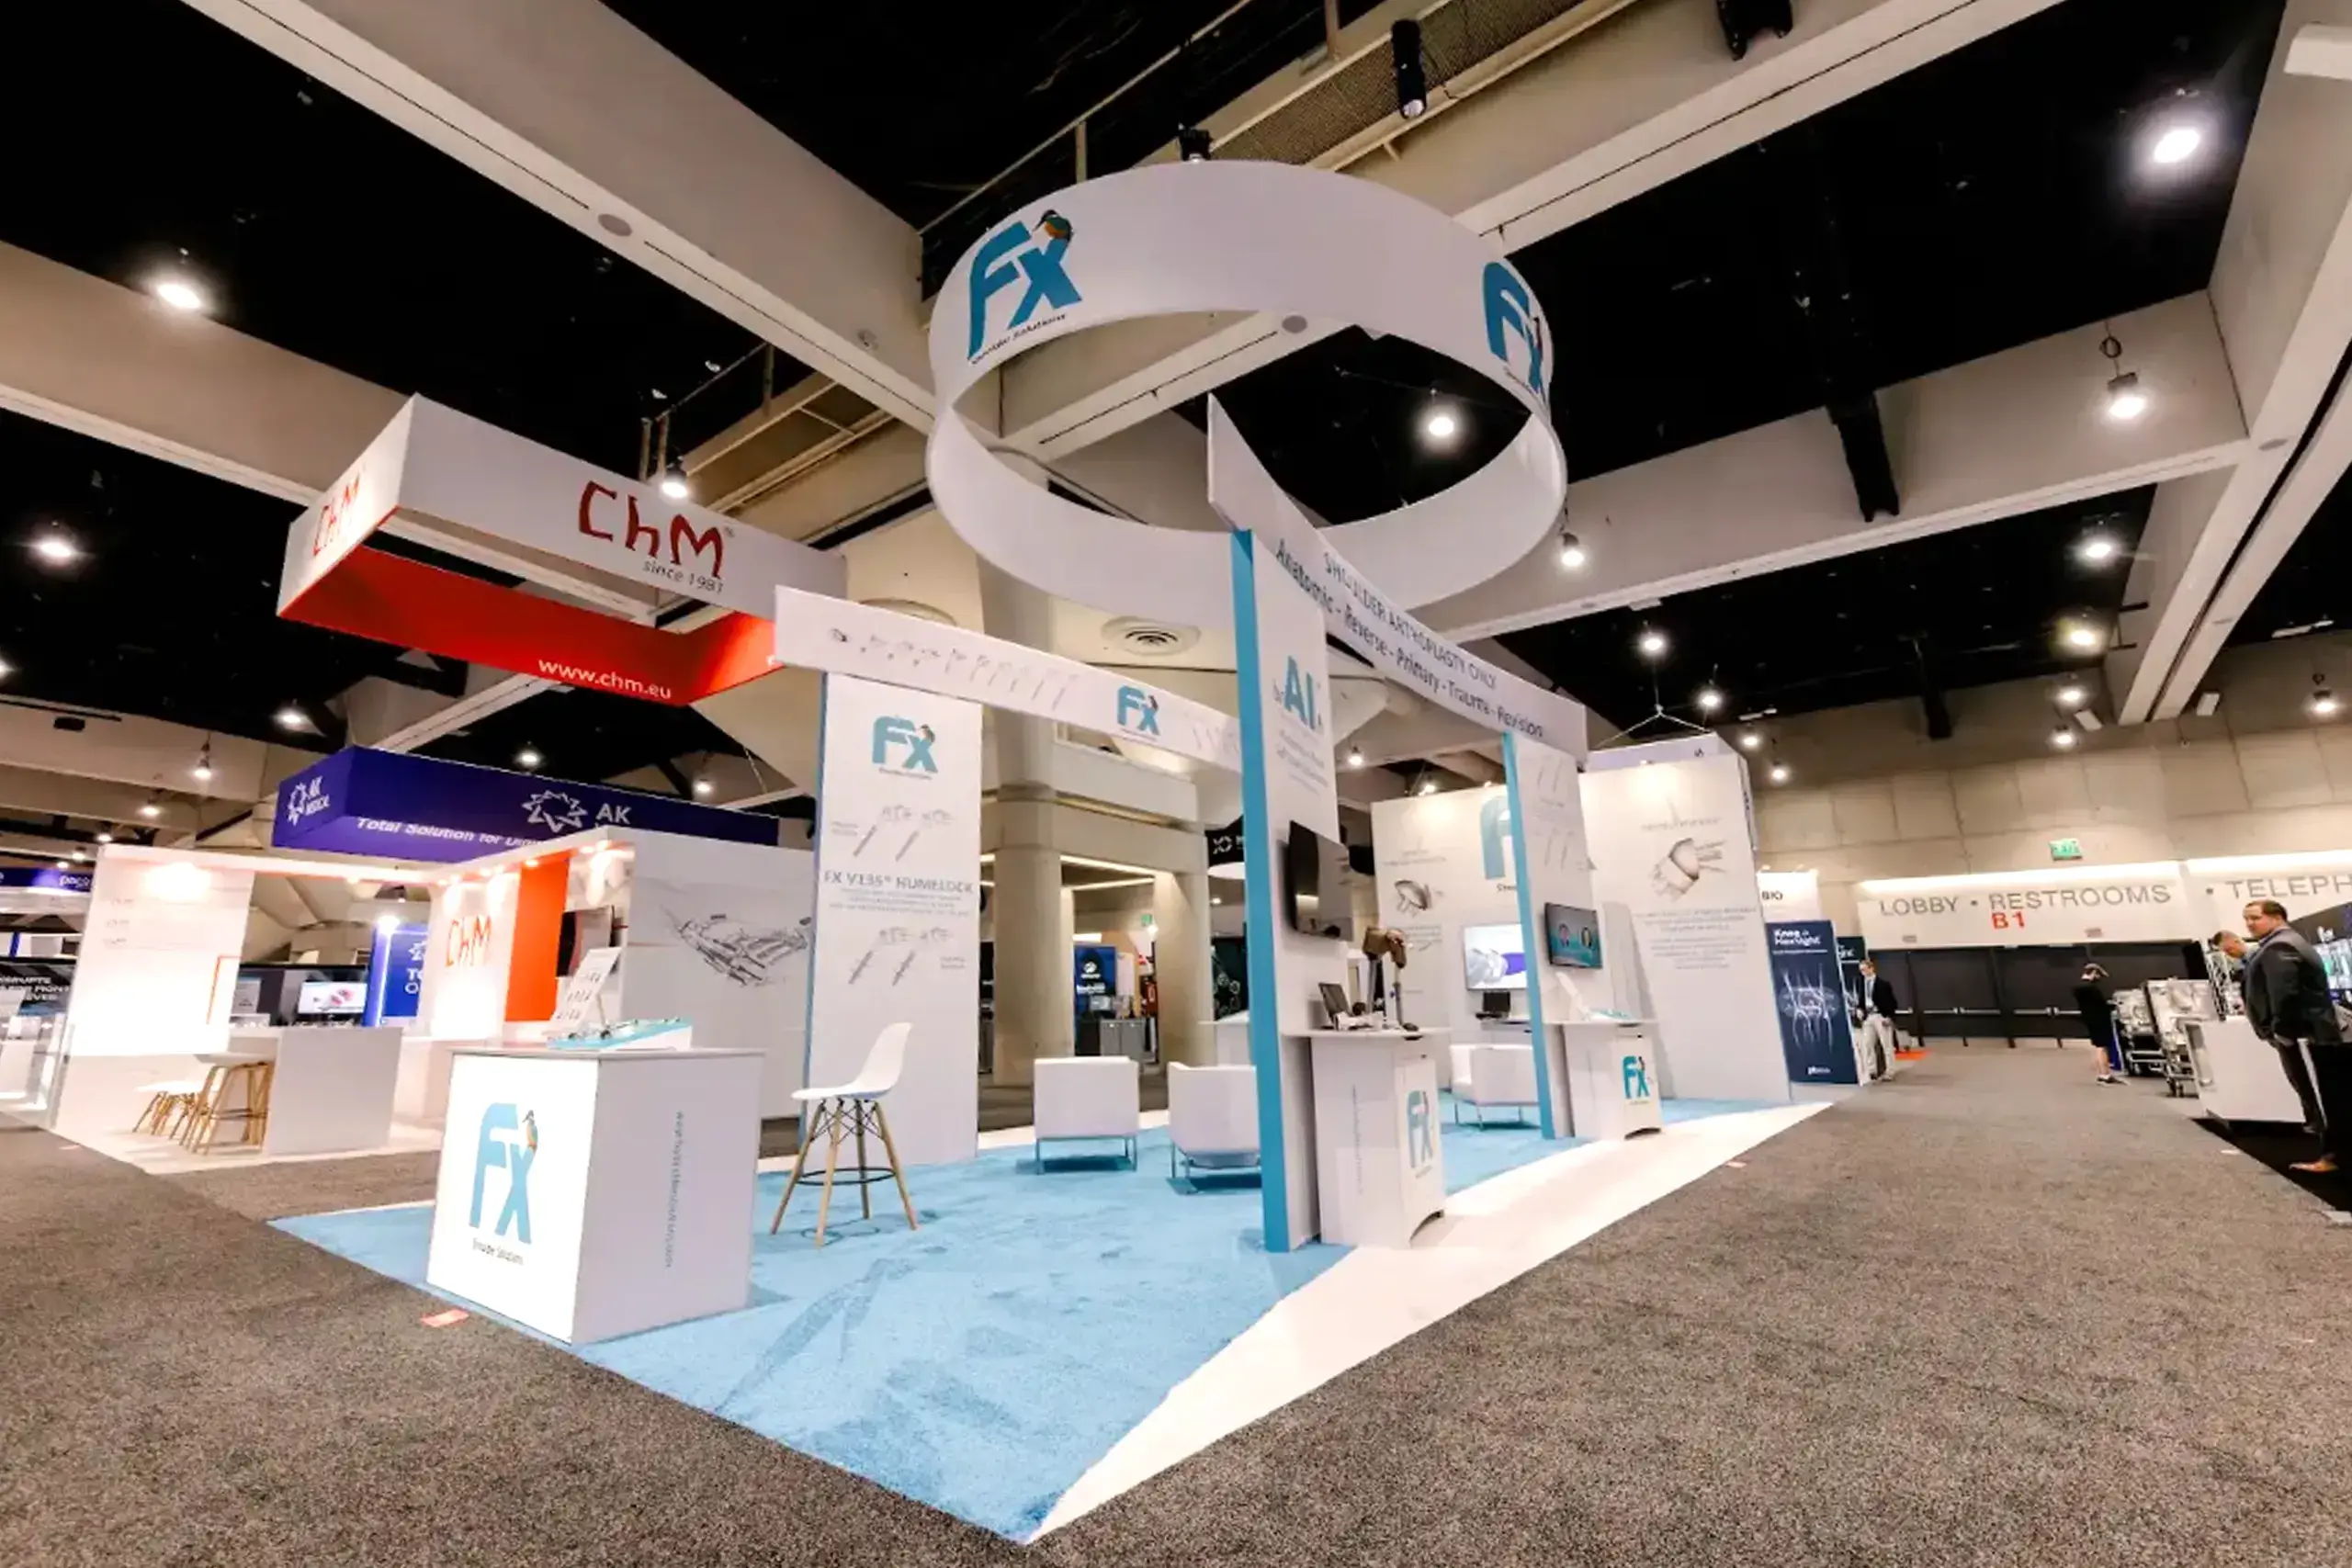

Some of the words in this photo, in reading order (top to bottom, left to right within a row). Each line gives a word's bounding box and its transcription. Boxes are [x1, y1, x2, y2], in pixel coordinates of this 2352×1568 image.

[579, 480, 723, 580] ChM
[642, 560, 684, 581] since
[537, 659, 672, 700] www.chm.eu
[1396, 646, 1441, 694] Primary
[1498, 705, 1544, 738] Revision
[357, 817, 401, 834] Total
[403, 823, 475, 841] Solution
[595, 803, 631, 824] AK
[1879, 896, 1959, 917] LOBBY
[1988, 884, 2172, 911] RESTROOMS
